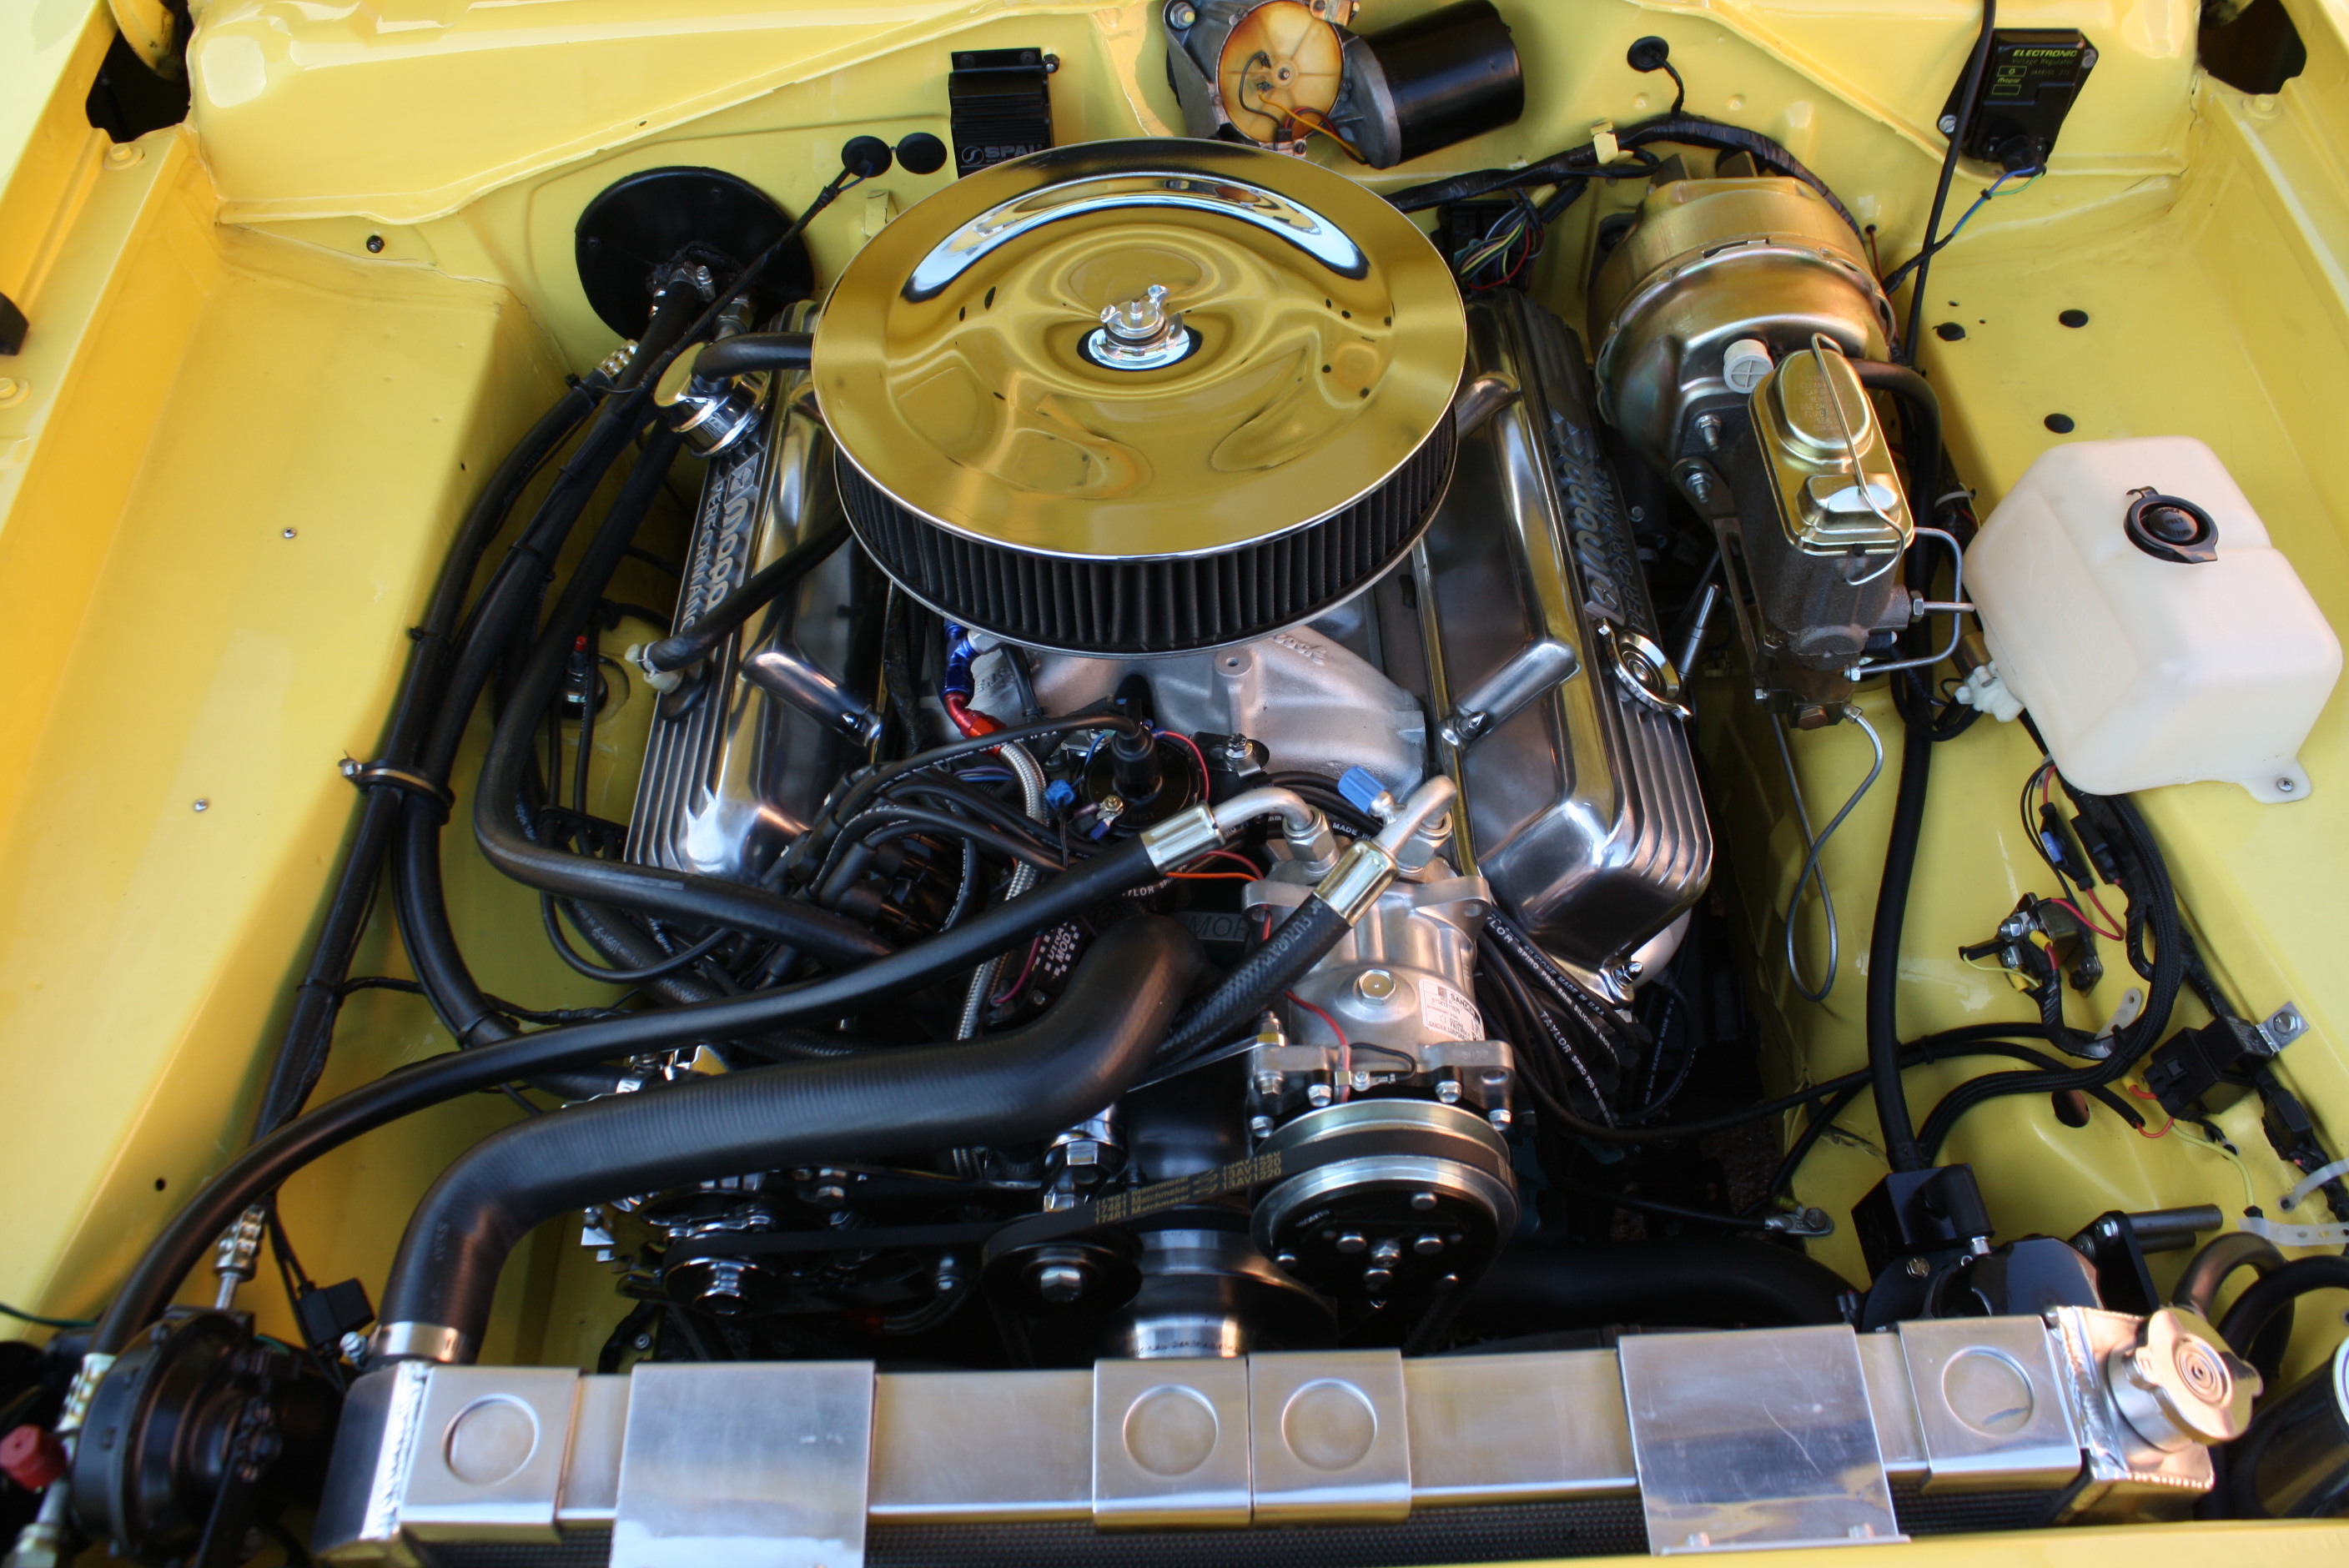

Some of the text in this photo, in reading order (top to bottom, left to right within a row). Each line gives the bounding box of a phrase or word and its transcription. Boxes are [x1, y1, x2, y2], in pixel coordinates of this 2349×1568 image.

[680, 482, 725, 632] PERFORMANC
[1333, 822, 1357, 836] MADE
[1054, 932, 1071, 963] MOD
[1517, 947, 1539, 969] SPIRO
[1541, 970, 1557, 987] PRO
[1557, 988, 1572, 1005] 8mm
[1573, 1004, 1598, 1034] SILICONE
[1557, 976, 1578, 994] MADE
[1540, 1010, 1572, 1053] TAYLOR
[1572, 1055, 1587, 1076] SPIRO
[1131, 1185, 1189, 1205] Matchmaker
[1222, 1157, 1281, 1179] 13AV1220
[1131, 1194, 1189, 1216] Matchmaker
[1222, 1168, 1282, 1190] 13AV1220
